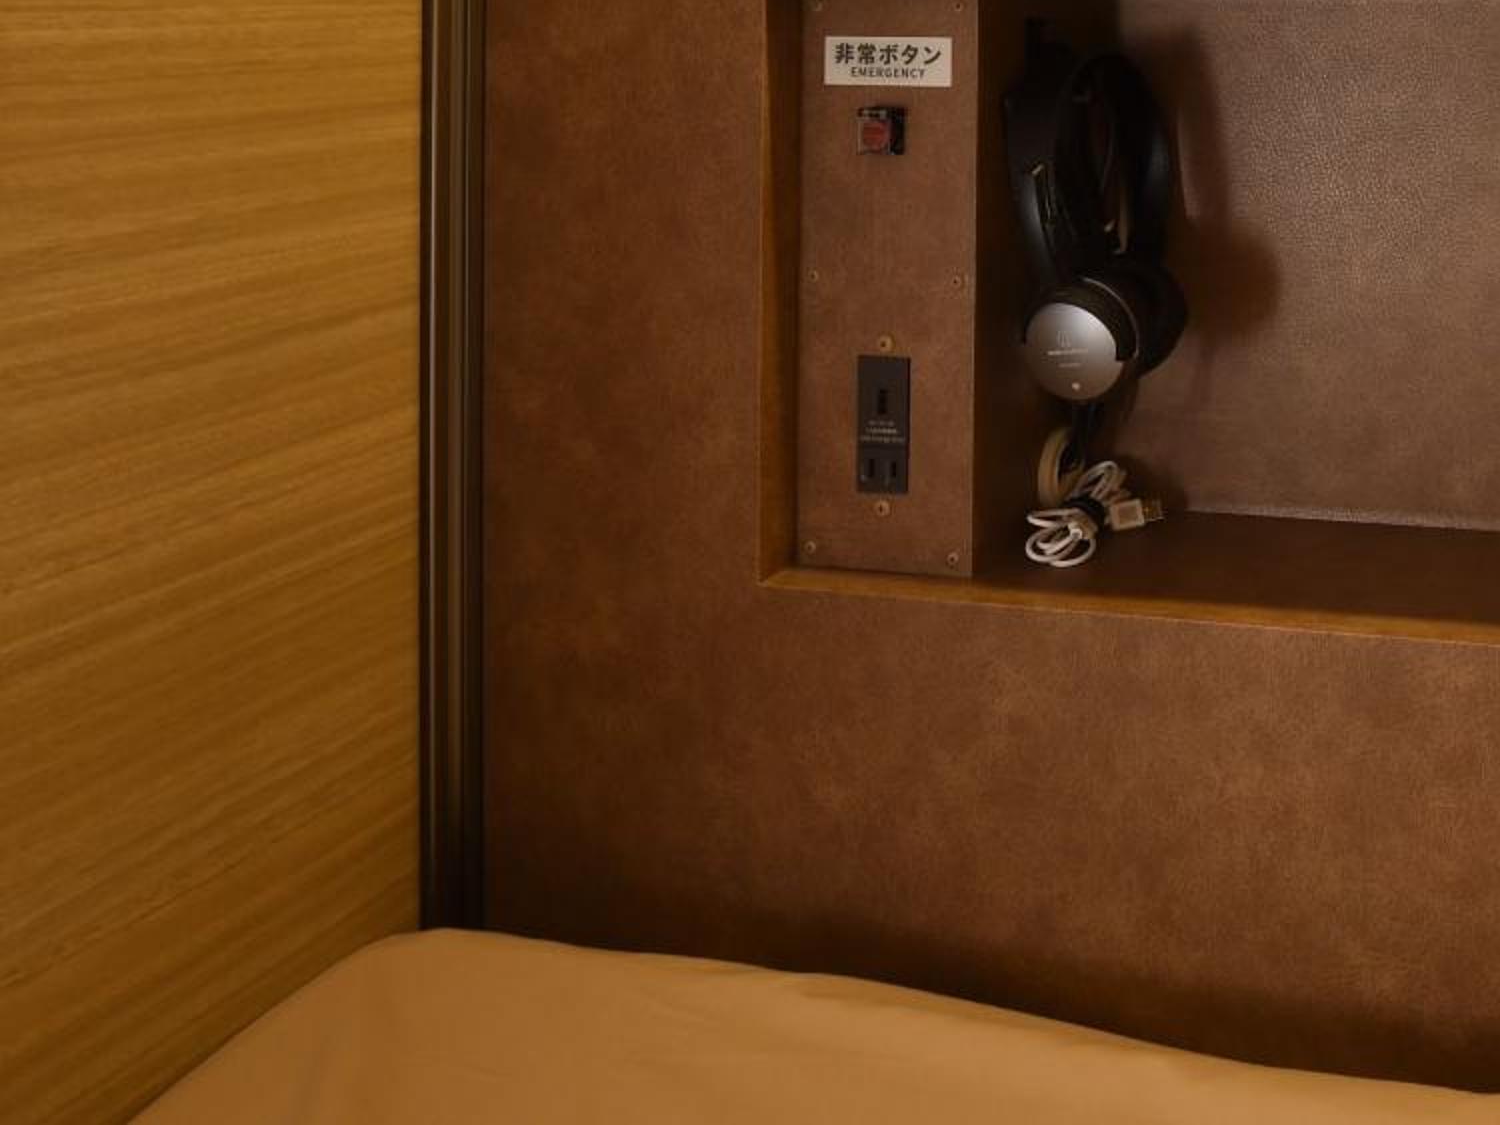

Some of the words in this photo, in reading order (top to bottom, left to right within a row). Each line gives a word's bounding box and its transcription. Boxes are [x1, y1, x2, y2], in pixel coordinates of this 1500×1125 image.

[834, 42, 942, 65] 非常ボタン
[850, 66, 926, 79] EMERGENCY
